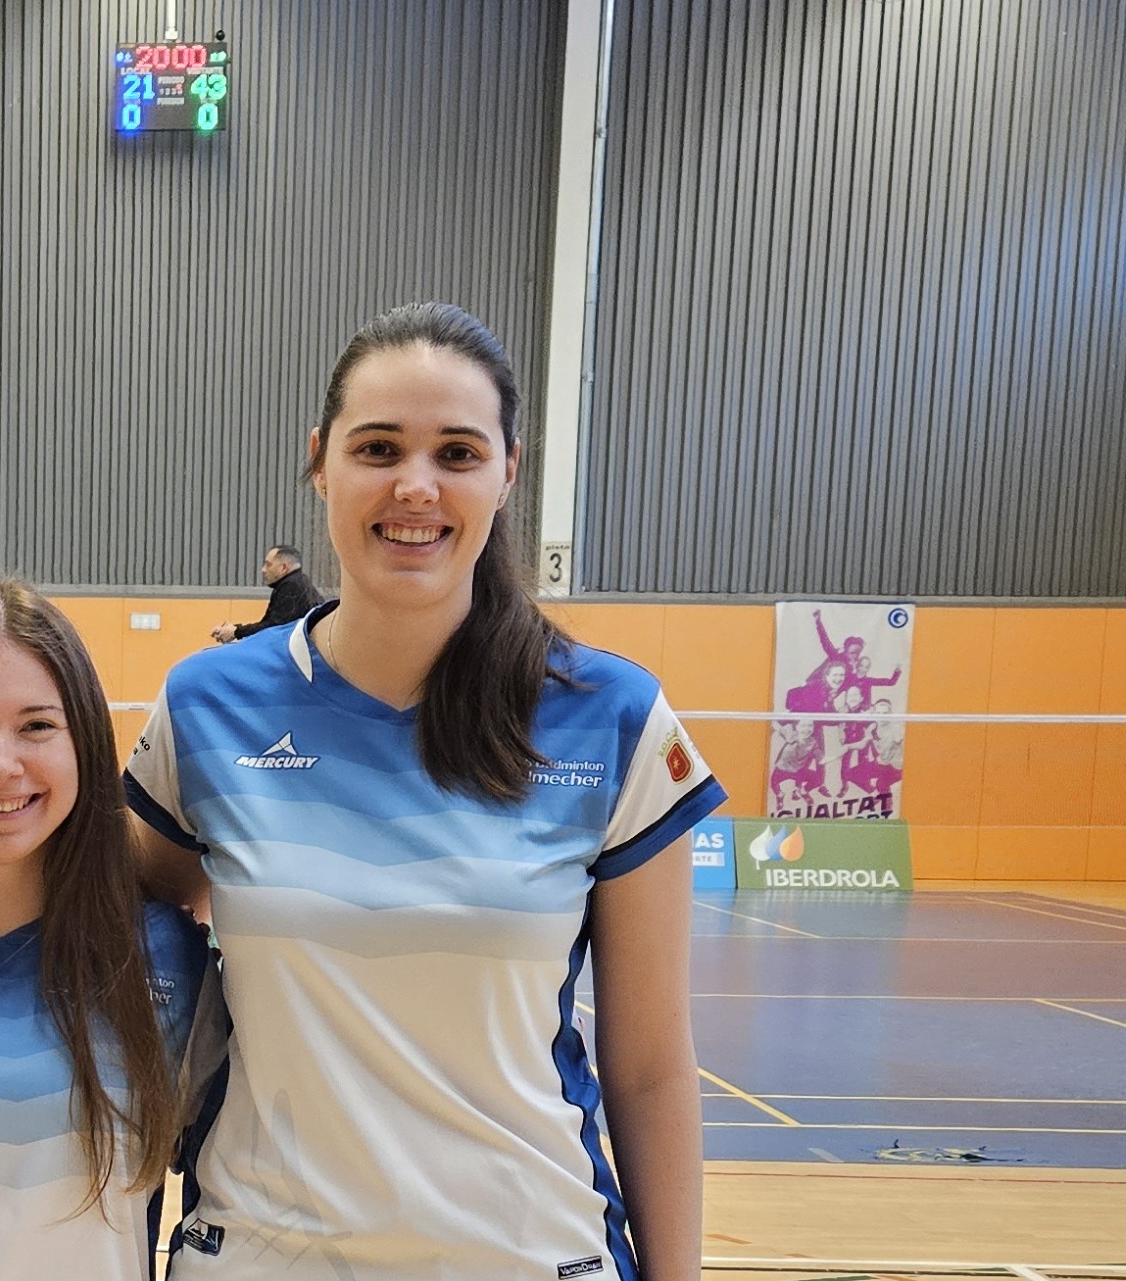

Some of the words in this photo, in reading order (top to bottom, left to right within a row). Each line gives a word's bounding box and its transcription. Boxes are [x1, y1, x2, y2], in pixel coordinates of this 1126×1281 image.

[122, 73, 155, 99] 21
[190, 73, 227, 100] 43
[122, 103, 141, 130] 0
[197, 103, 218, 130] 0
[549, 552, 562, 582] 3
[235, 755, 320, 769] MERCURY
[765, 868, 901, 888] IBERDROLA
